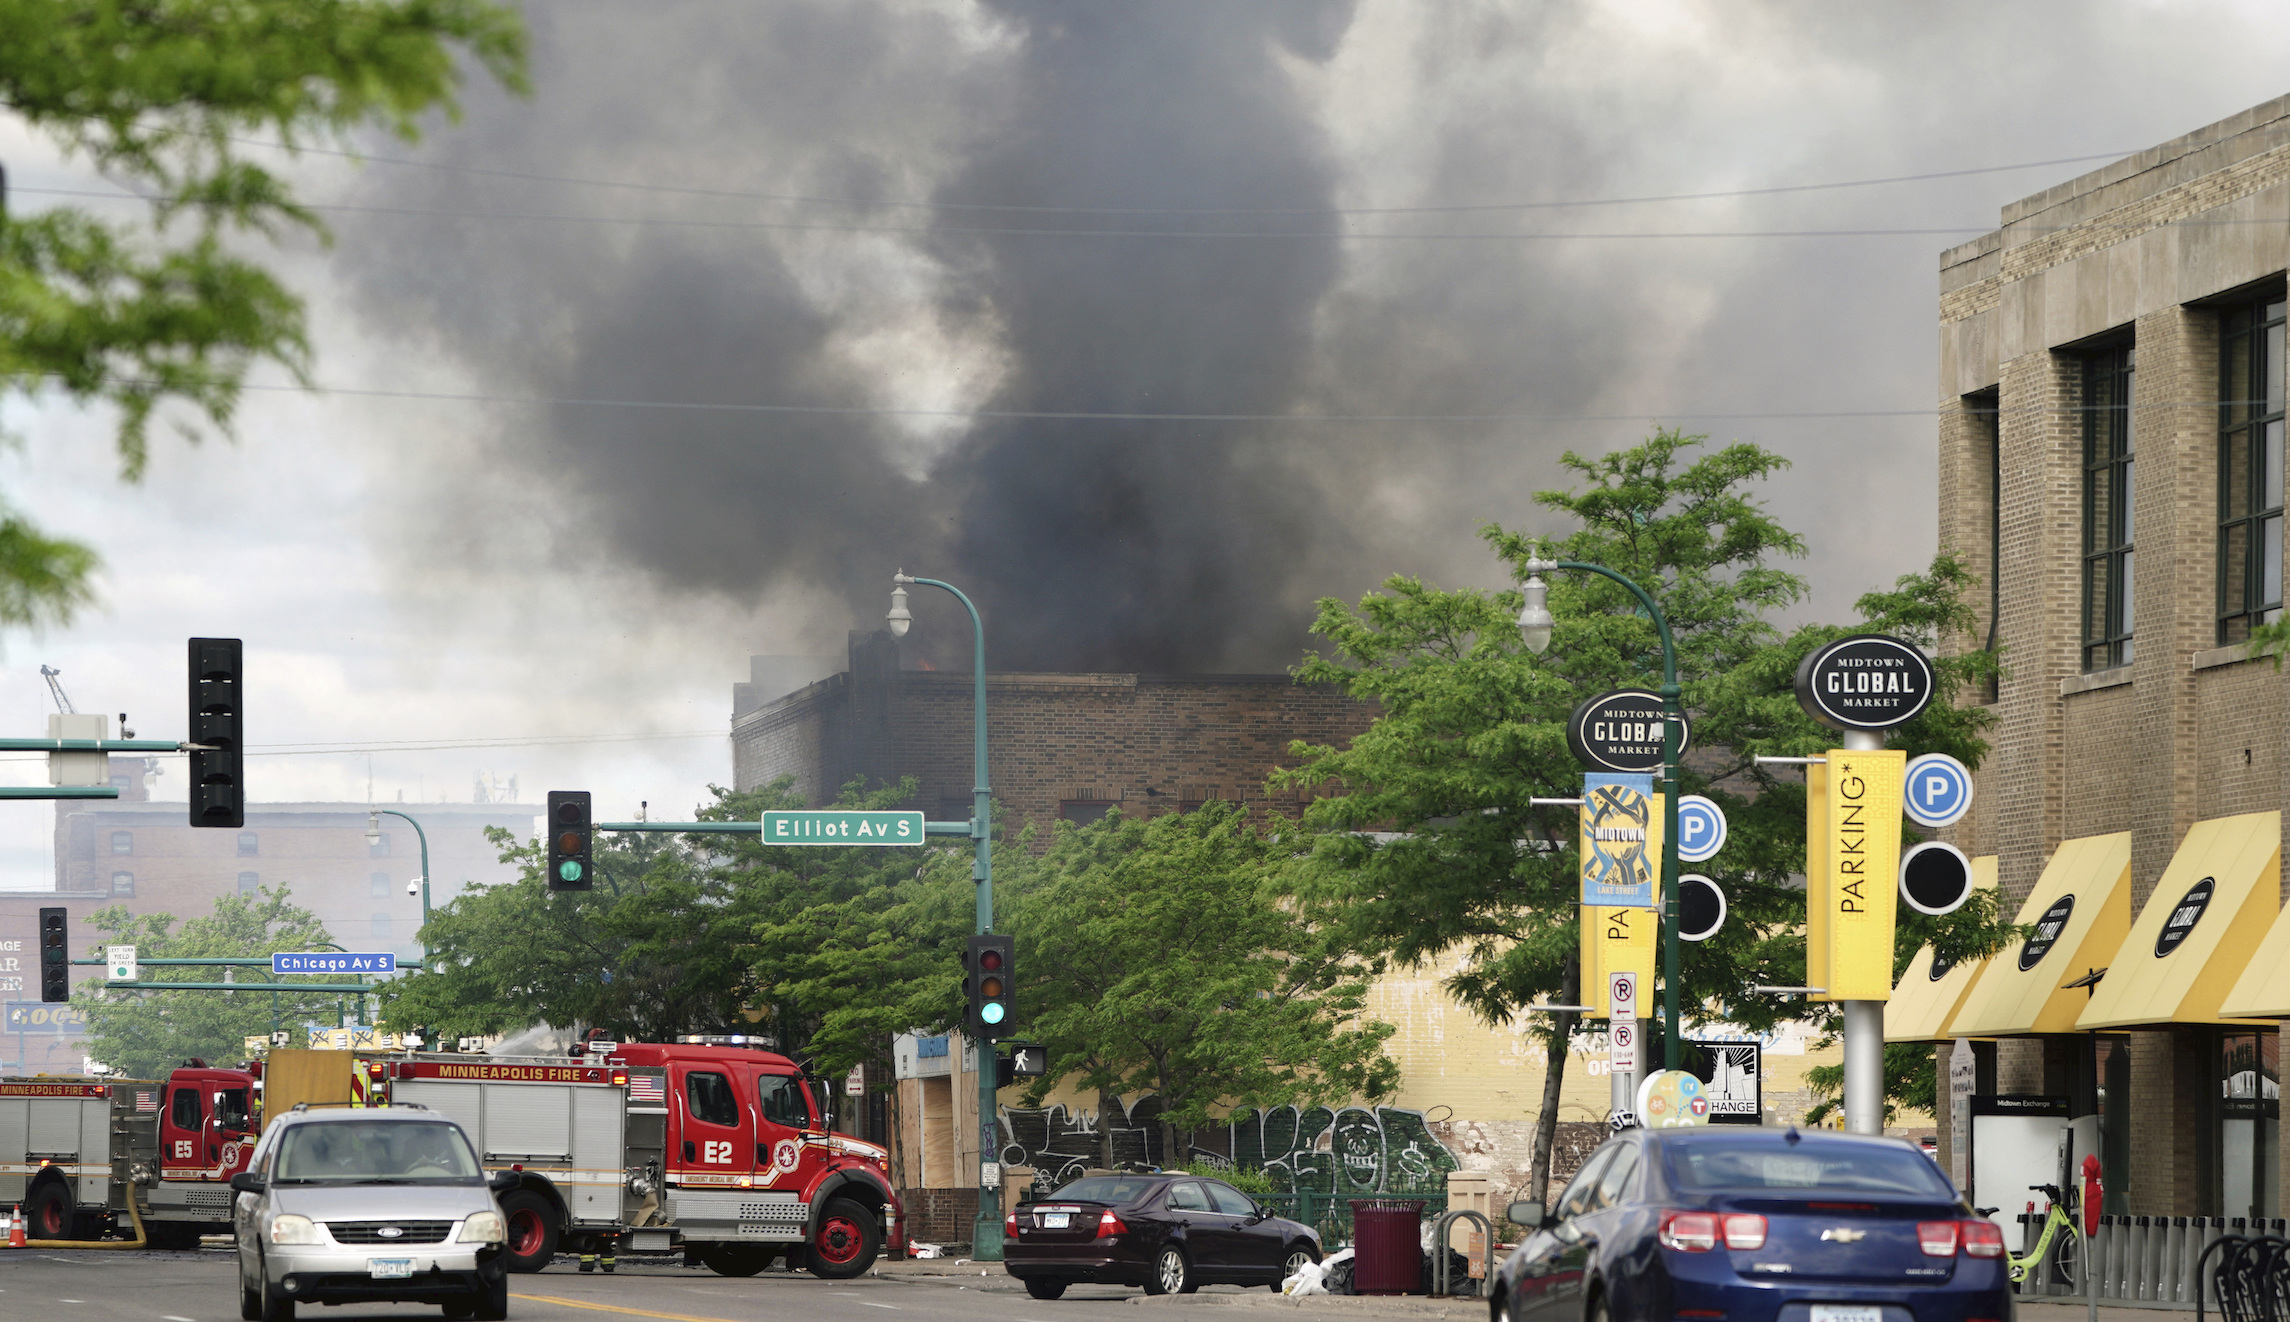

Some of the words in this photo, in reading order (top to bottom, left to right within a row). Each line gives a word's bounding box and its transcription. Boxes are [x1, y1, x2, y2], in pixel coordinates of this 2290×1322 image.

[1837, 658, 1904, 667] MIDTOWN
[1827, 671, 1915, 694] GLOBAL
[1843, 698, 1900, 707] MARKET
[1604, 710, 1664, 719] MIDTOWN
[1608, 746, 1660, 755] MARKET
[1926, 776, 1949, 805] P
[776, 819, 849, 837] Elliot
[857, 819, 888, 837] Av
[896, 819, 911, 837] S
[1594, 827, 1645, 842] MIDTOWN
[1684, 816, 1705, 842] P
[1597, 886, 1614, 894] LAKE
[1615, 886, 1639, 896] STREET
[2169, 905, 2202, 928] GLOBAL
[281, 957, 346, 972] Chicago
[352, 957, 372, 970] Av
[378, 957, 388, 969] S
[439, 1065, 544, 1080] MINNEAPOLIS
[549, 1068, 581, 1081] FIRE
[0, 1085, 62, 1095] MINNEAPOLIS
[65, 1086, 84, 1095] FIRE
[1709, 1102, 1755, 1113] HANGE
[175, 1140, 193, 1158] E5
[704, 1140, 733, 1164] E2
